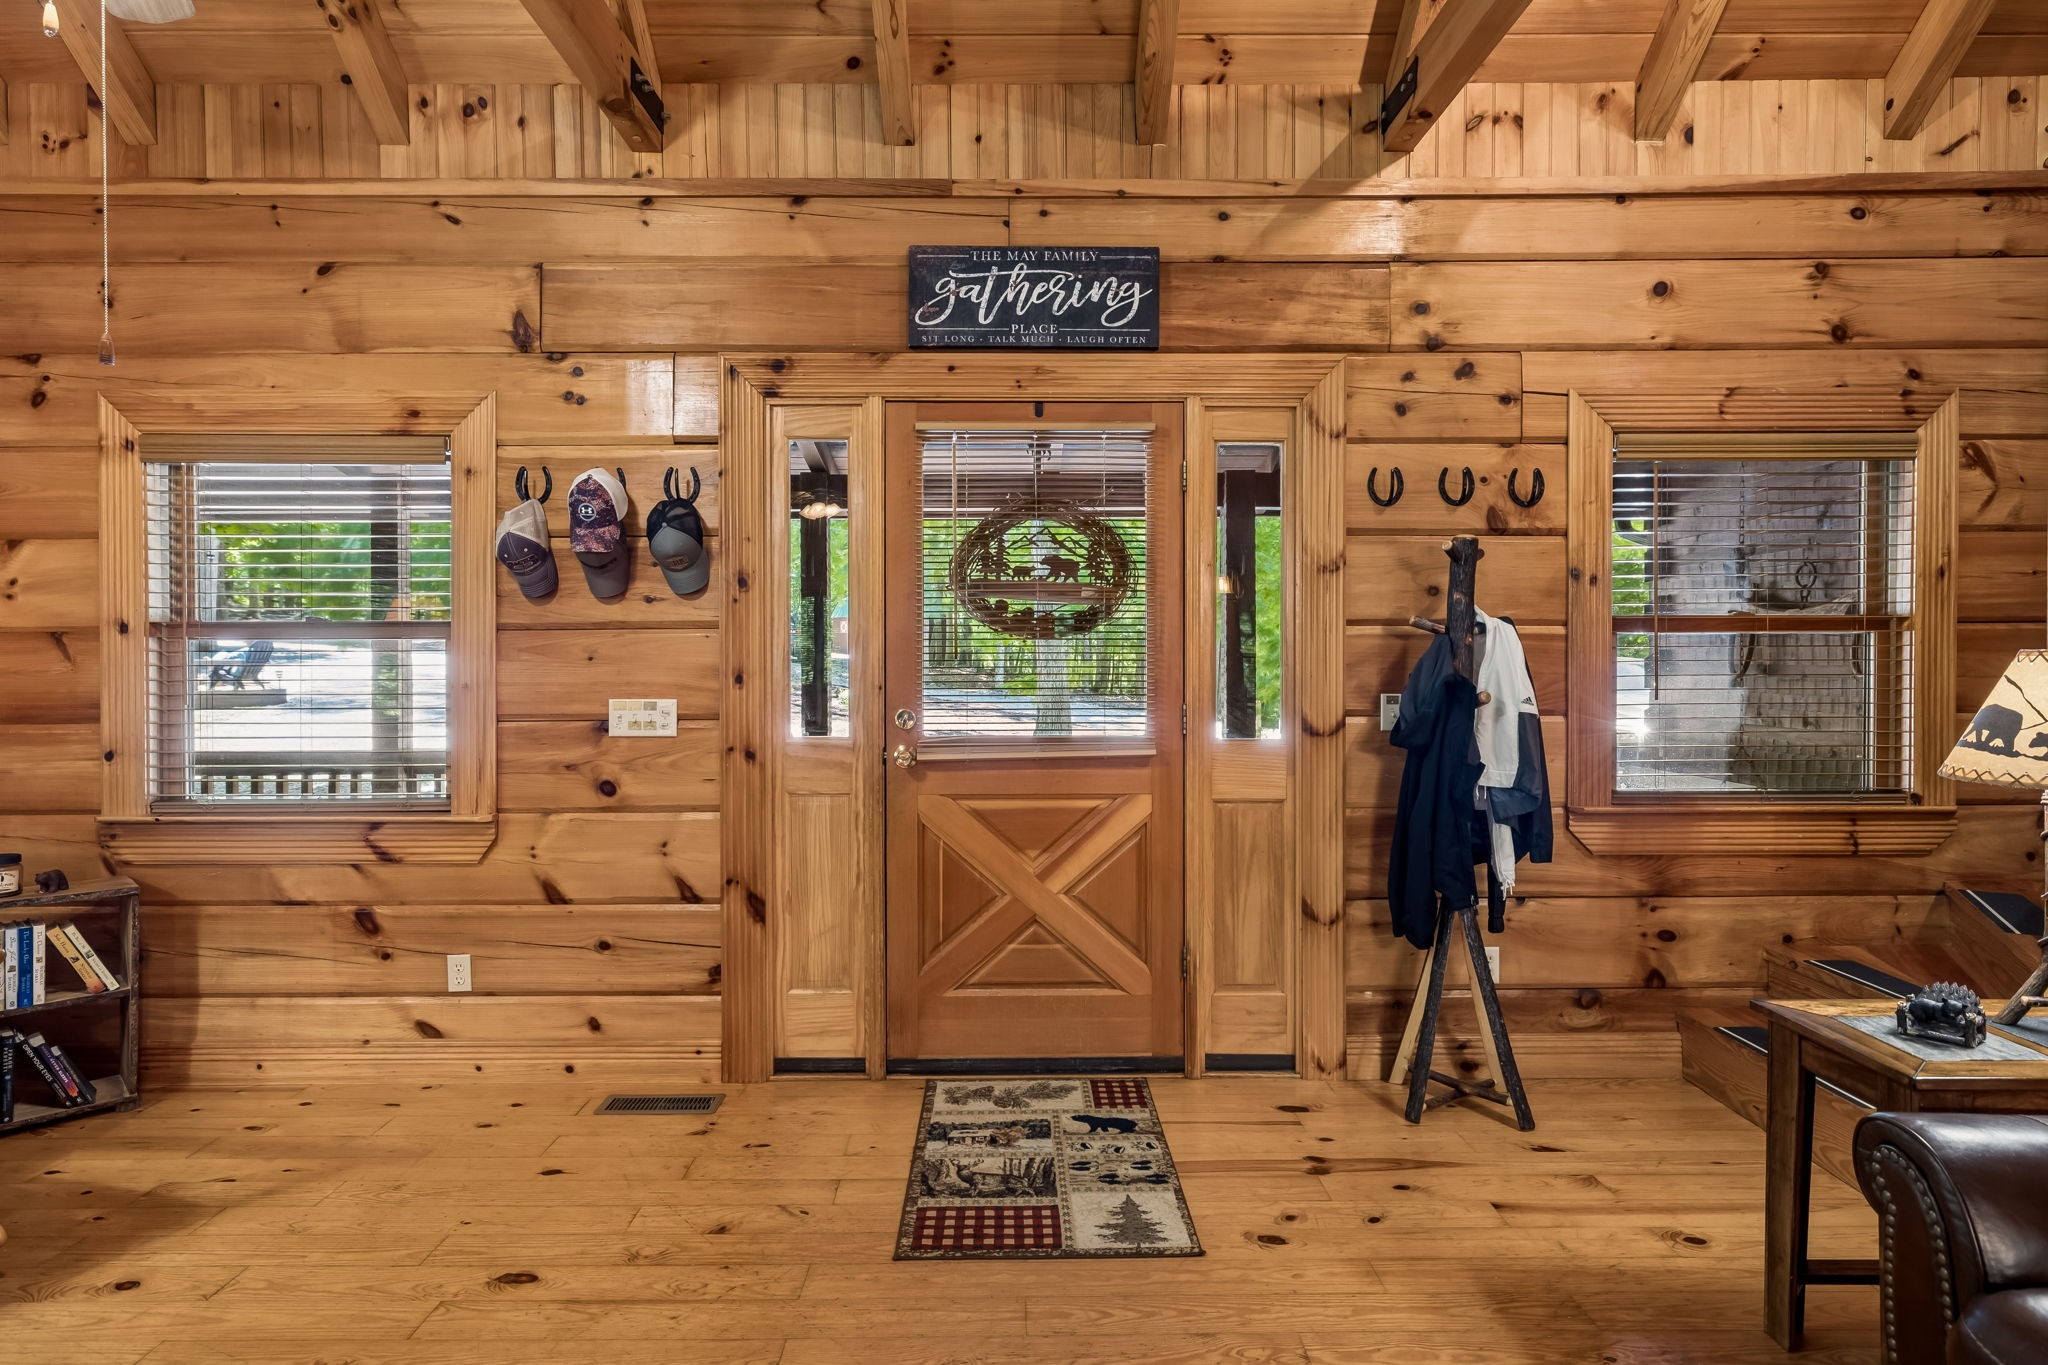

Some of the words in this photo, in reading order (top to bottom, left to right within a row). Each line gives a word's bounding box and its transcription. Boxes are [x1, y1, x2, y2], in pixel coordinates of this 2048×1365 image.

[970, 250, 1001, 261] THE
[1007, 250, 1038, 261] MAY
[1044, 250, 1099, 262] FAMILY
[914, 262, 1153, 327] gathering
[1011, 324, 1058, 334] PLACE
[921, 335, 940, 343] SIT
[944, 335, 975, 343] LONG
[987, 335, 1017, 343] TALK
[1021, 335, 1054, 343] MUCH
[1067, 335, 1104, 343] LAUGH
[1109, 336, 1146, 344] OFTEN
[22, 1044, 34, 1058] OPEN
[32, 1056, 45, 1071] YOUR
[41, 1069, 53, 1082] EYES
